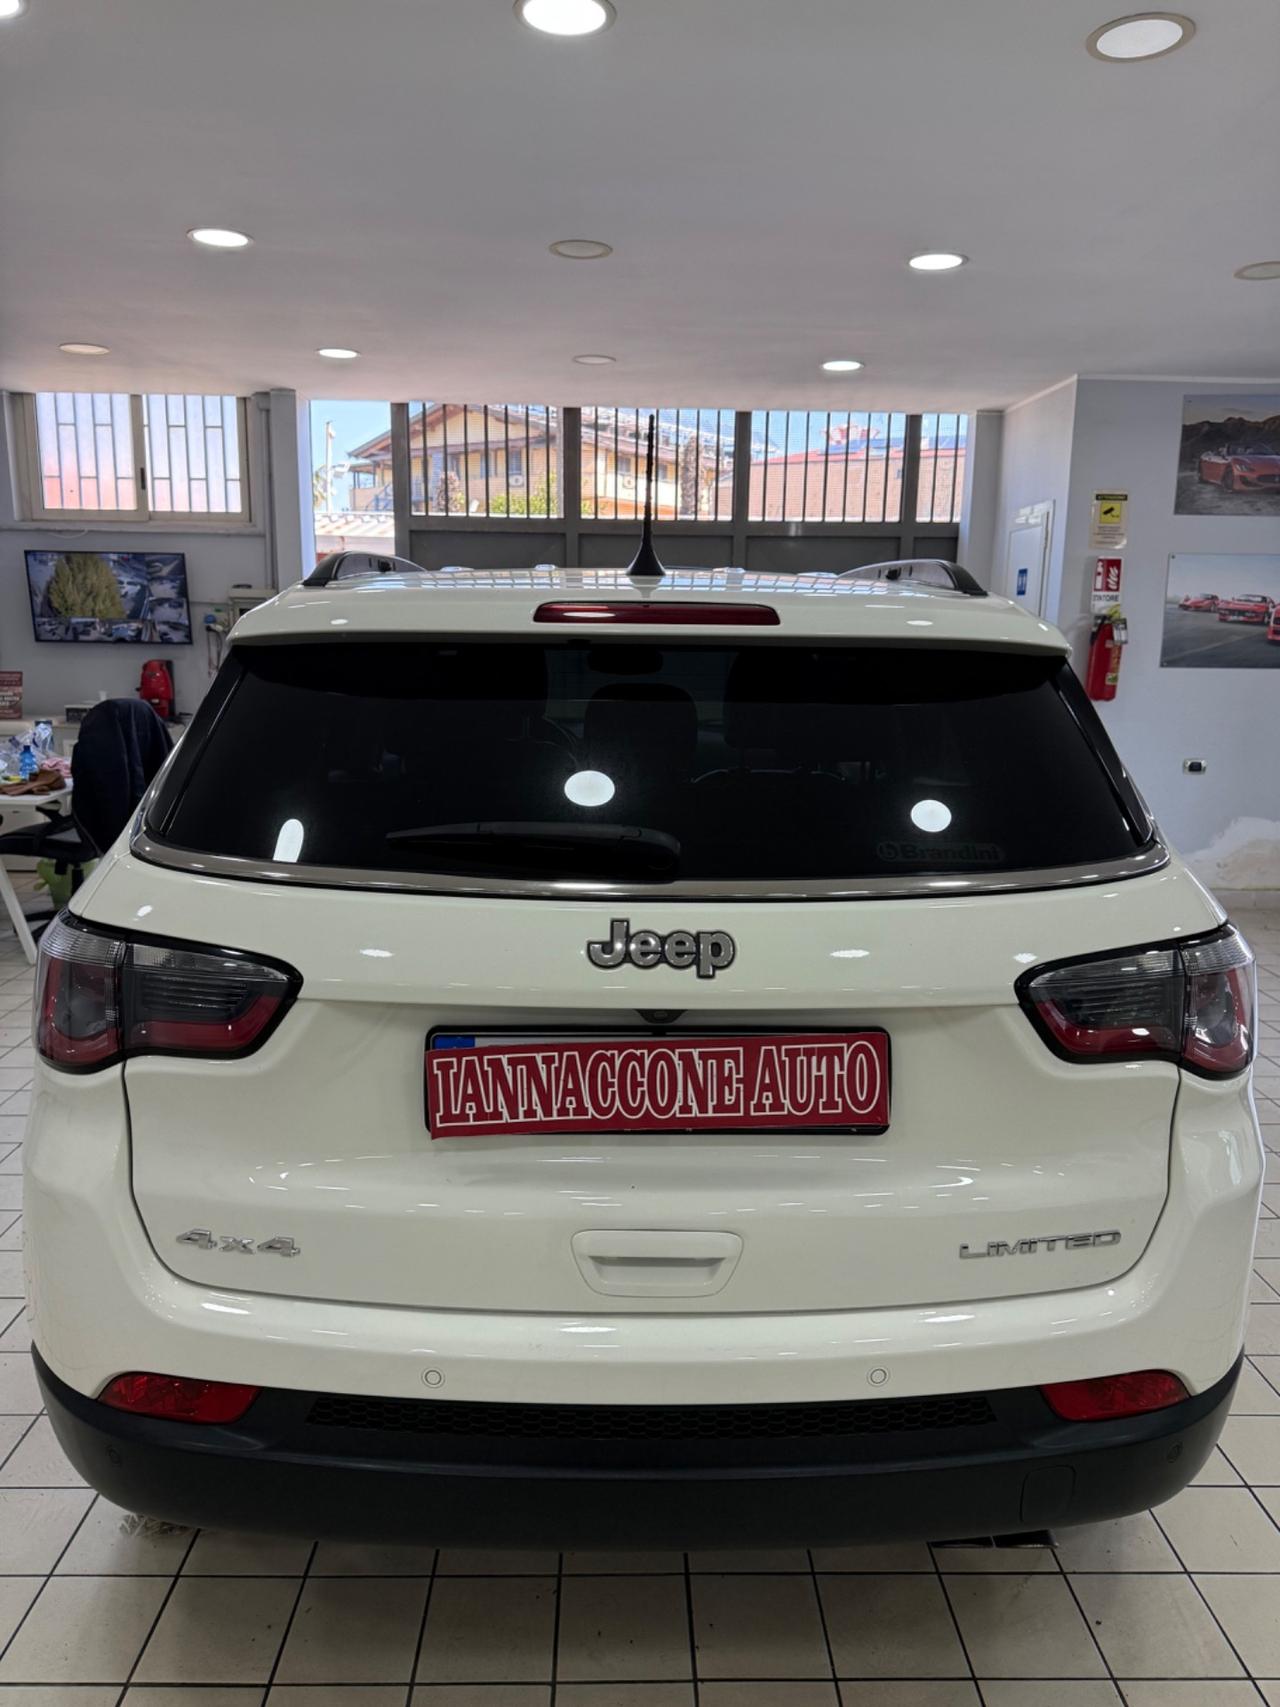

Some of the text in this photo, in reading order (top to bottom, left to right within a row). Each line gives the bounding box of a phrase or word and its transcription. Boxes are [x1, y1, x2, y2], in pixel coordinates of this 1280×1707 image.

[900, 843, 1000, 861] Brandini
[587, 918, 736, 978] Jeep
[433, 1041, 881, 1128] IANNACCONE AUTO
[176, 1228, 301, 1257] 4x4
[959, 1229, 1122, 1260] LIMITED
